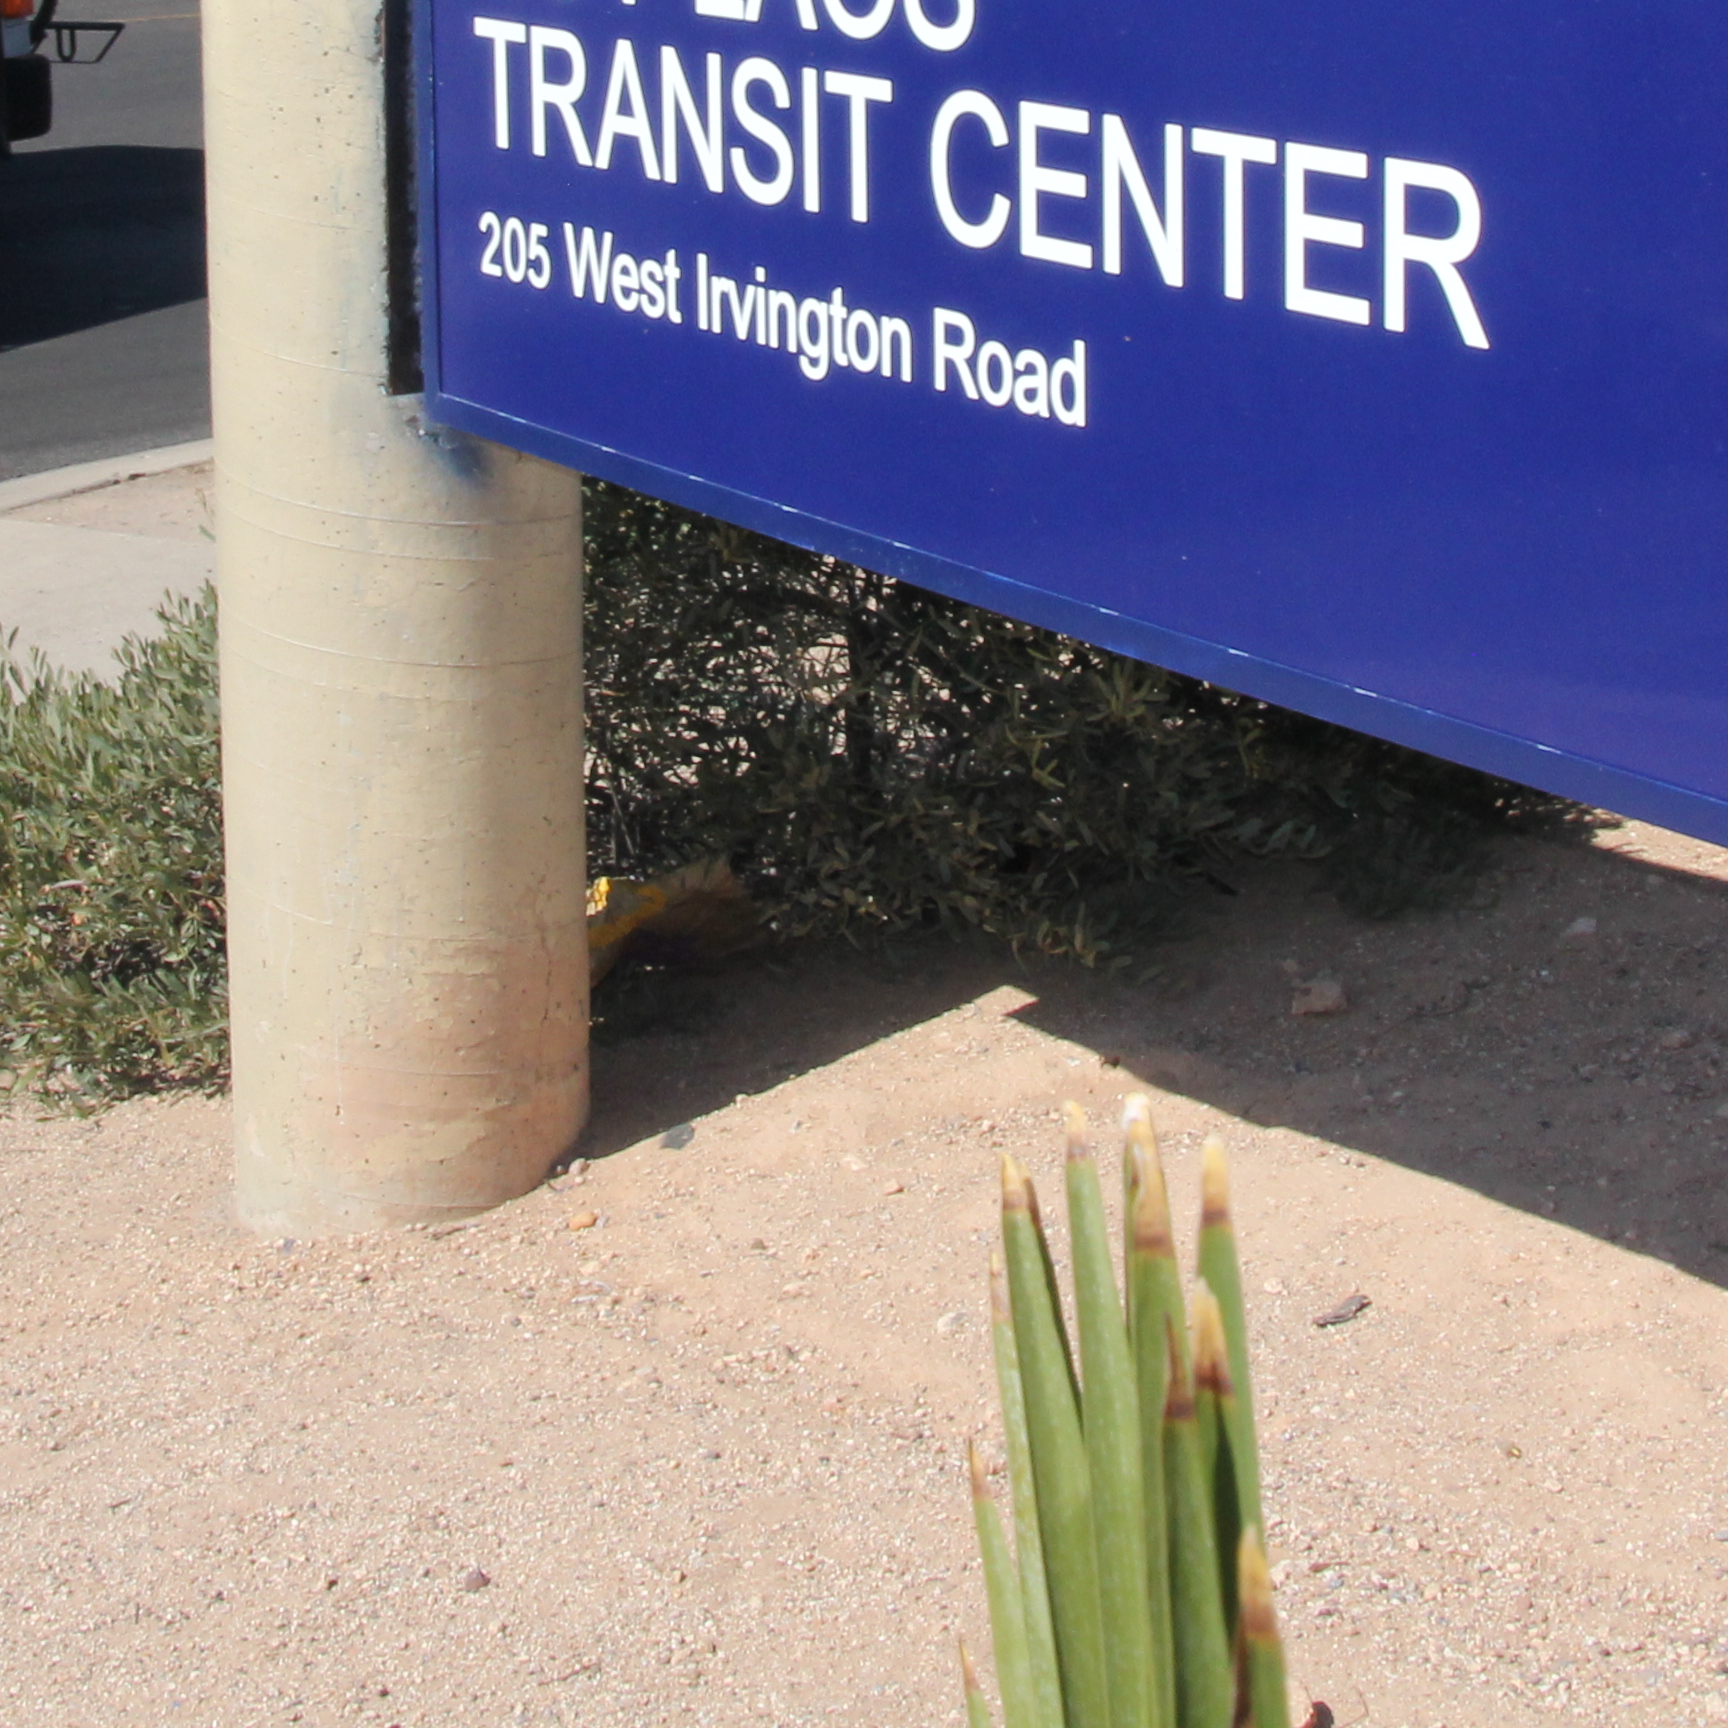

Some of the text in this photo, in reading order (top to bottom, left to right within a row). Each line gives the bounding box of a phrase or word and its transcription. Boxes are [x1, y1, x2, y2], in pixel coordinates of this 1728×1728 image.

[472, 16, 1491, 350] TRANSIT CENTER
[478, 211, 1087, 428] 205 West Irvington Road
